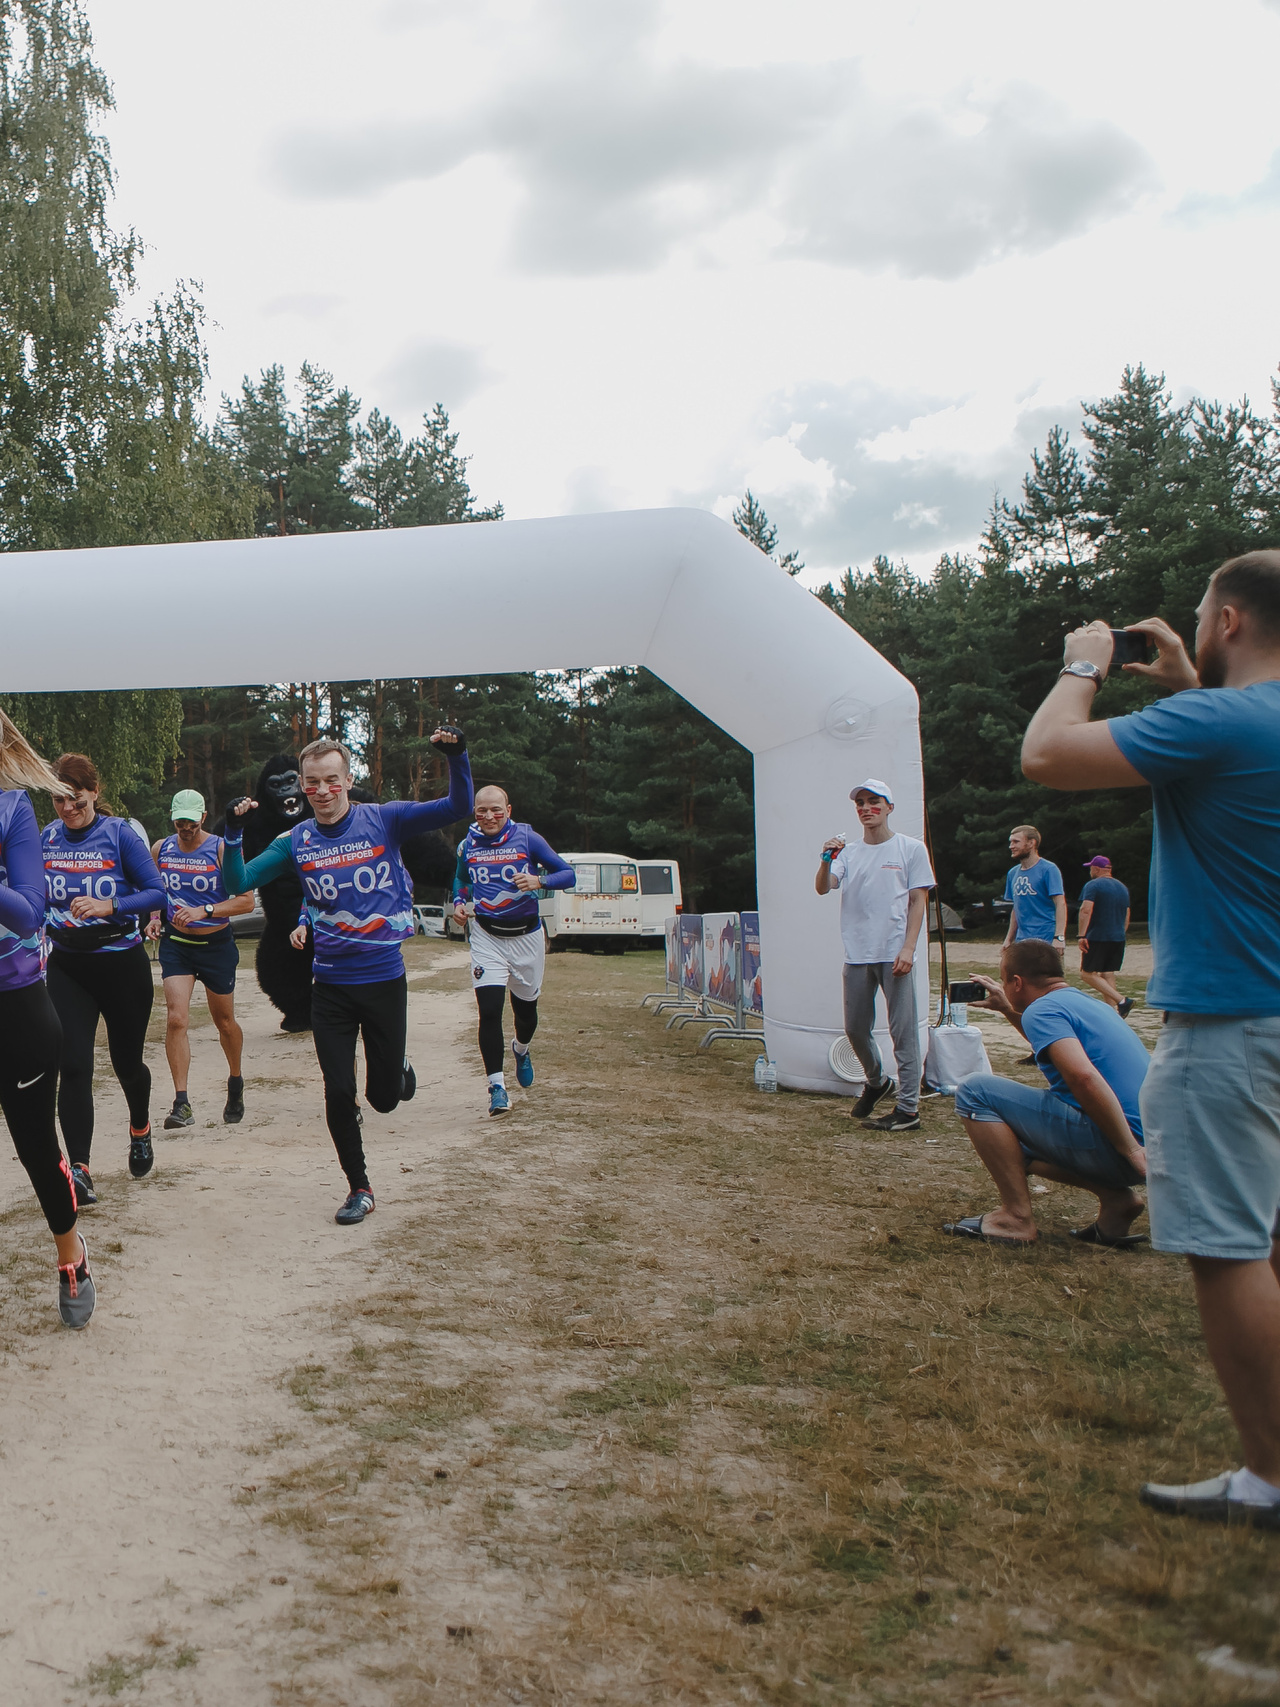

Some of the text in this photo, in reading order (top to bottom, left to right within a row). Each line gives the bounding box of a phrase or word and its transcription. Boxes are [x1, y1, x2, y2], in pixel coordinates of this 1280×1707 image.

[74, 851, 103, 860] ГОНКА
[296, 840, 371, 863] БОЛЬШАЯ ГОНКА
[315, 849, 374, 868] ВРЕМЯ ГЕРОЕВ
[74, 860, 103, 869] ГЕРОЕВ
[305, 861, 393, 900] 08-02
